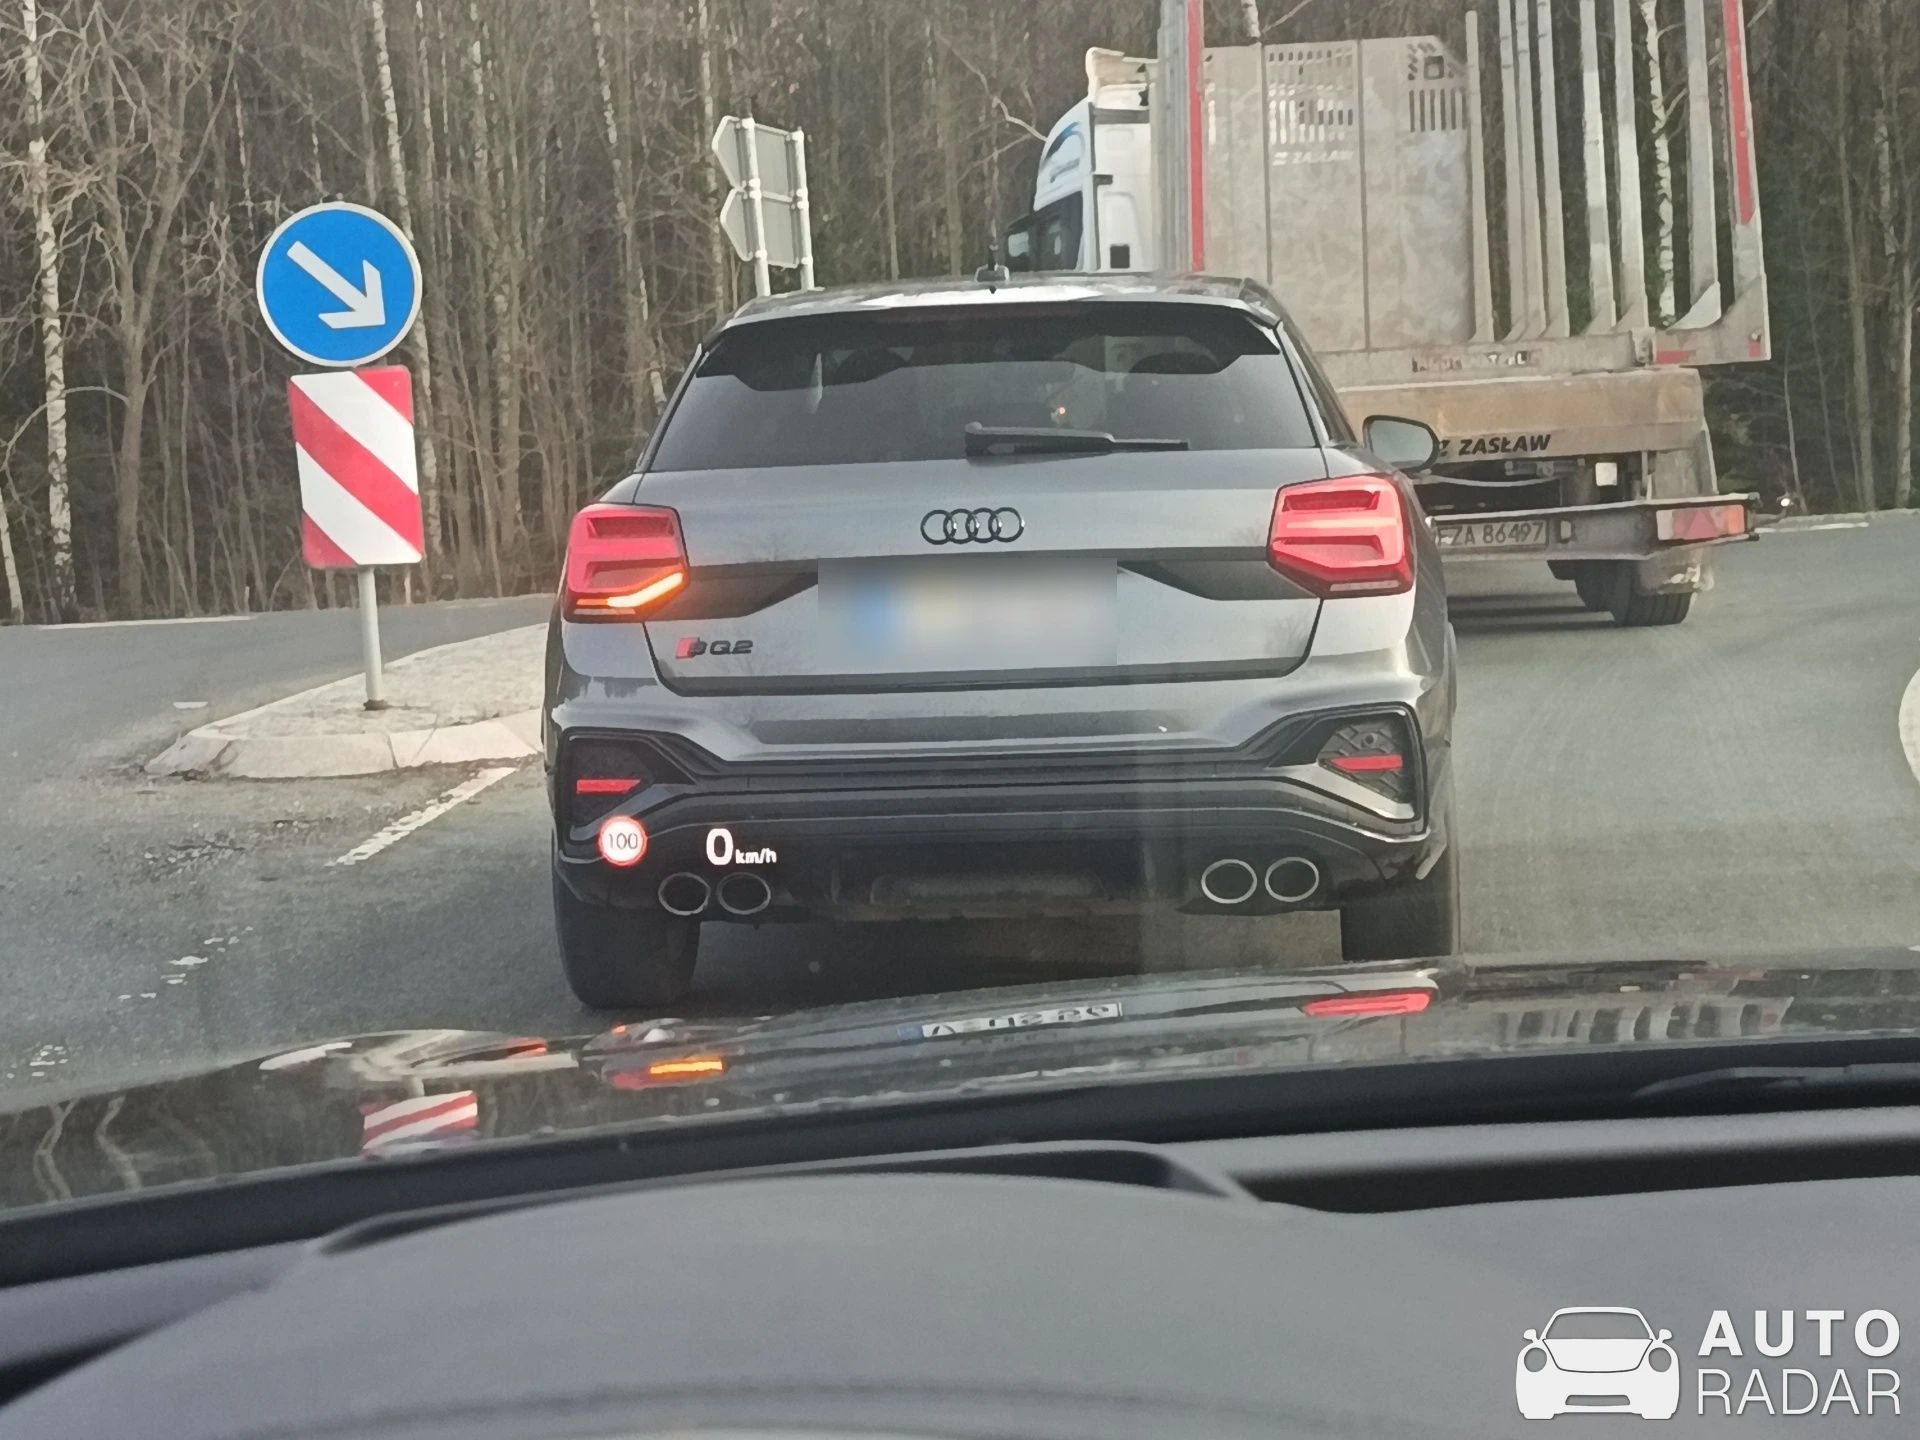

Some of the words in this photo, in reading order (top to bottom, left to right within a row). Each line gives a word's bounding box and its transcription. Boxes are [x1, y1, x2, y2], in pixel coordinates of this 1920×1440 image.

[1458, 434, 1551, 456] ZASŁAW
[1482, 522, 1544, 544] 86497
[608, 832, 638, 850] 100
[706, 828, 734, 866] 0
[735, 848, 777, 865] km/h
